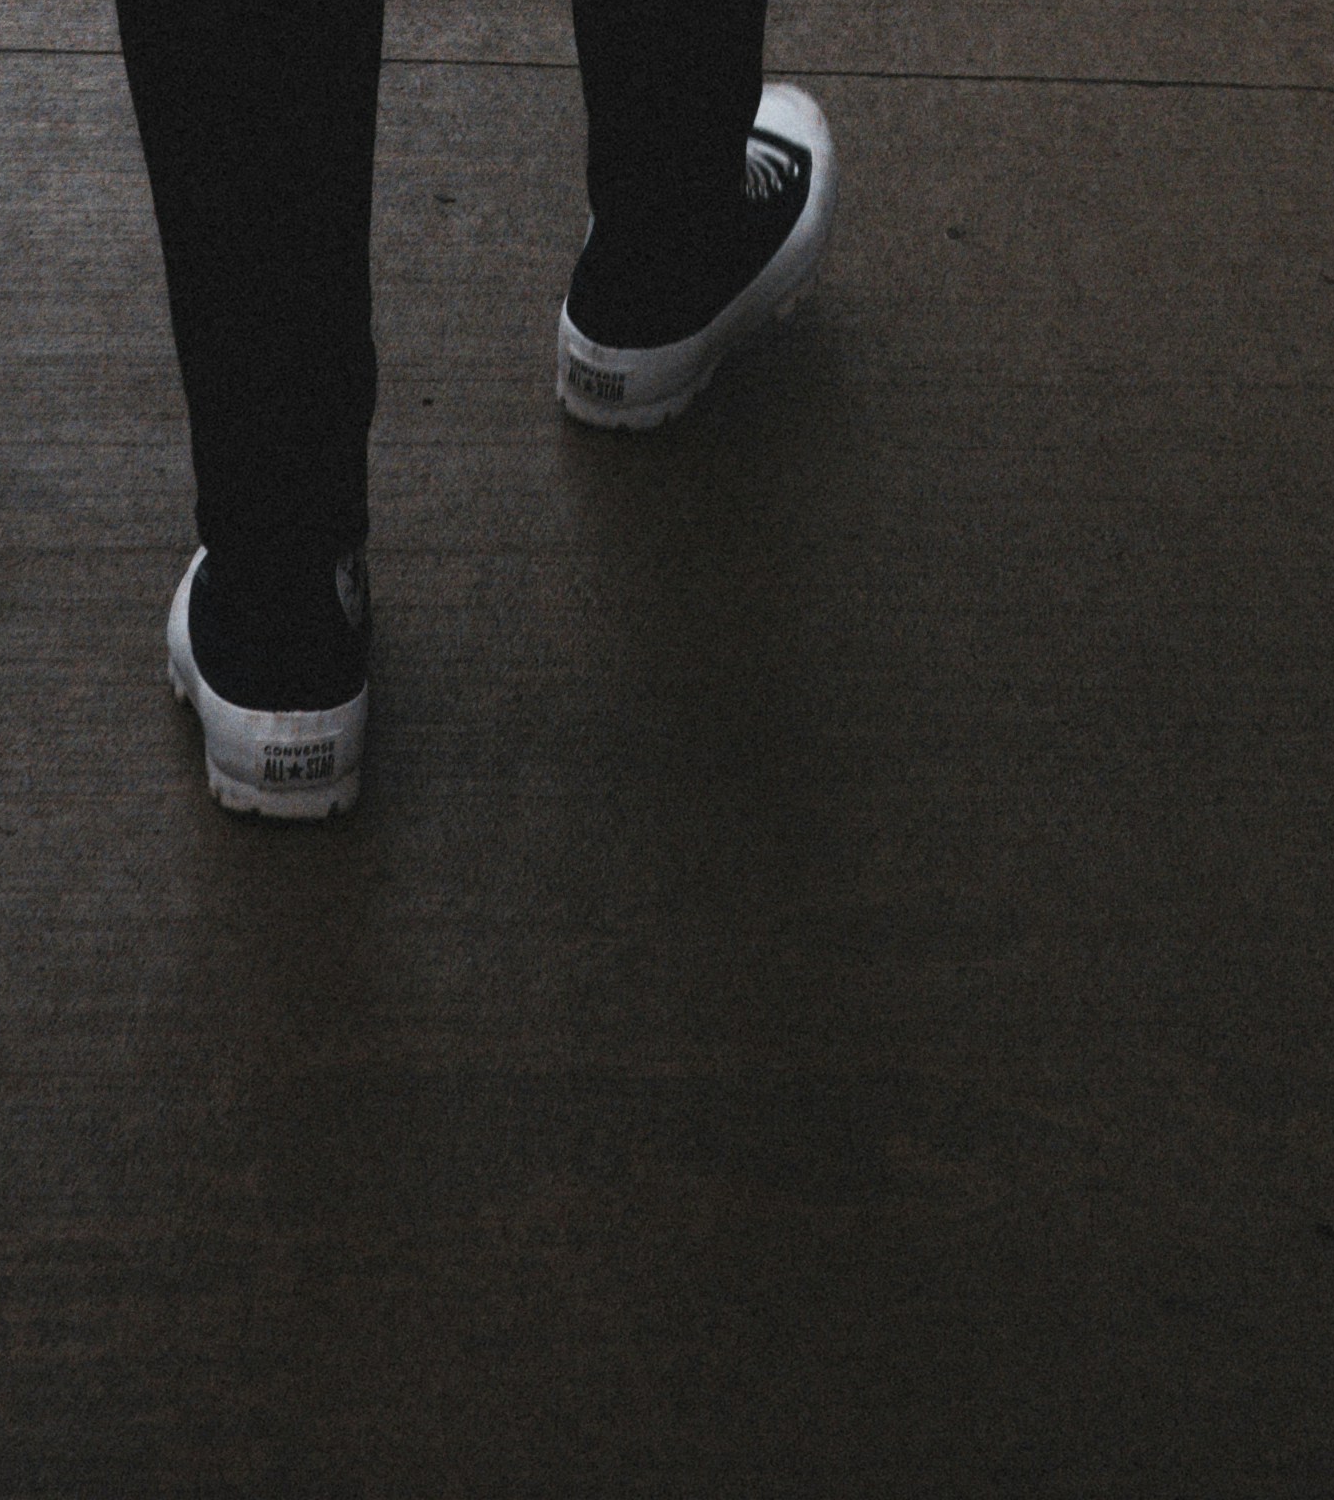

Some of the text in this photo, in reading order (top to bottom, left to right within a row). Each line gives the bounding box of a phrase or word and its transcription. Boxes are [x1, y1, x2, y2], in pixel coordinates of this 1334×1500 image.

[263, 741, 335, 757] CONVERSE
[263, 753, 335, 782] ALL STAR
